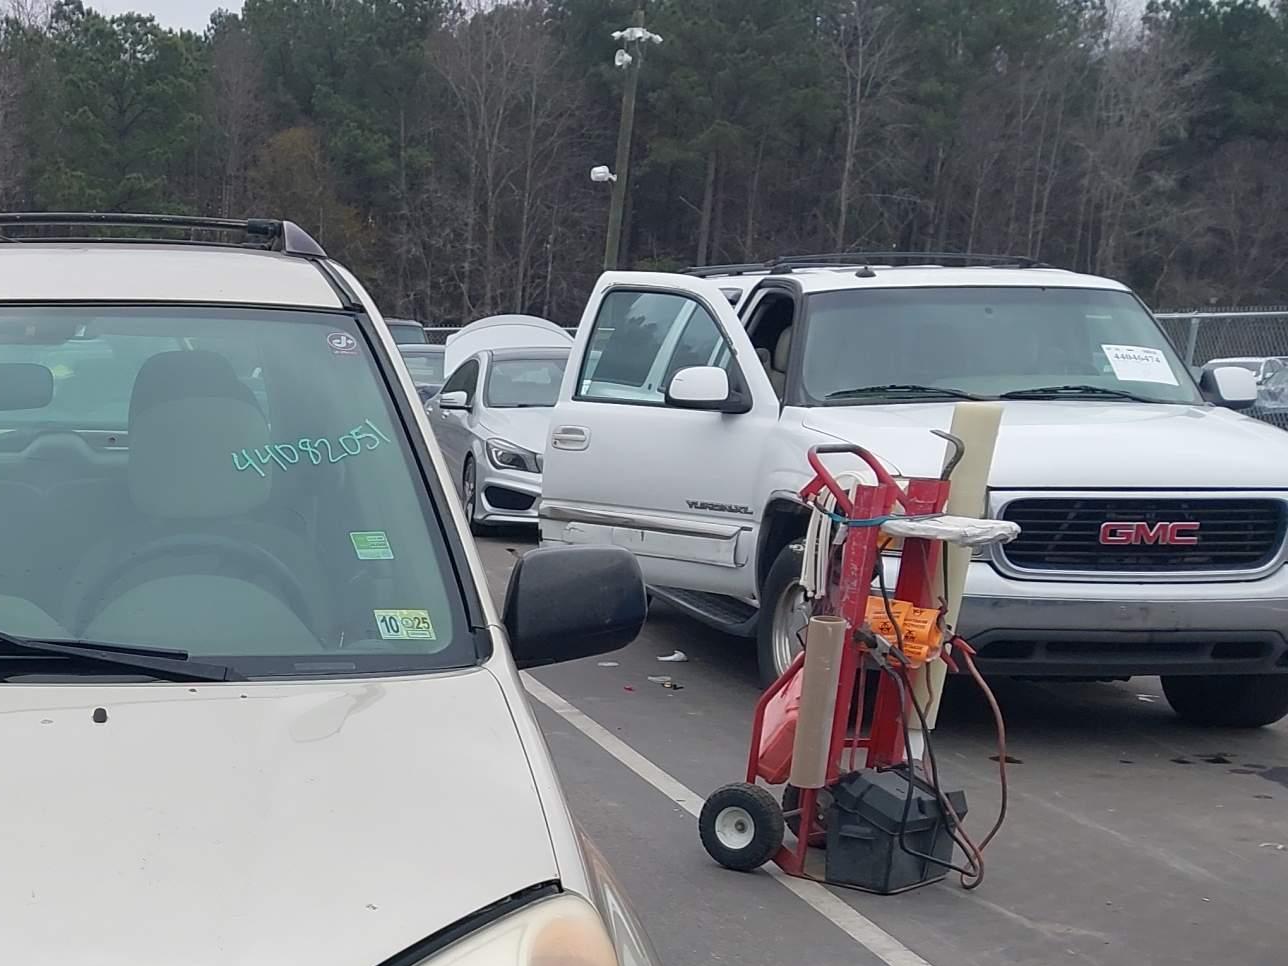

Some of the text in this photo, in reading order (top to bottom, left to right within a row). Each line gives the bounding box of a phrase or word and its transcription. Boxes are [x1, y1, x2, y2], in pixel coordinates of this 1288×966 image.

[231, 419, 391, 477] 44082051
[1099, 521, 1200, 545] GMC
[380, 615, 430, 633] 10 25
